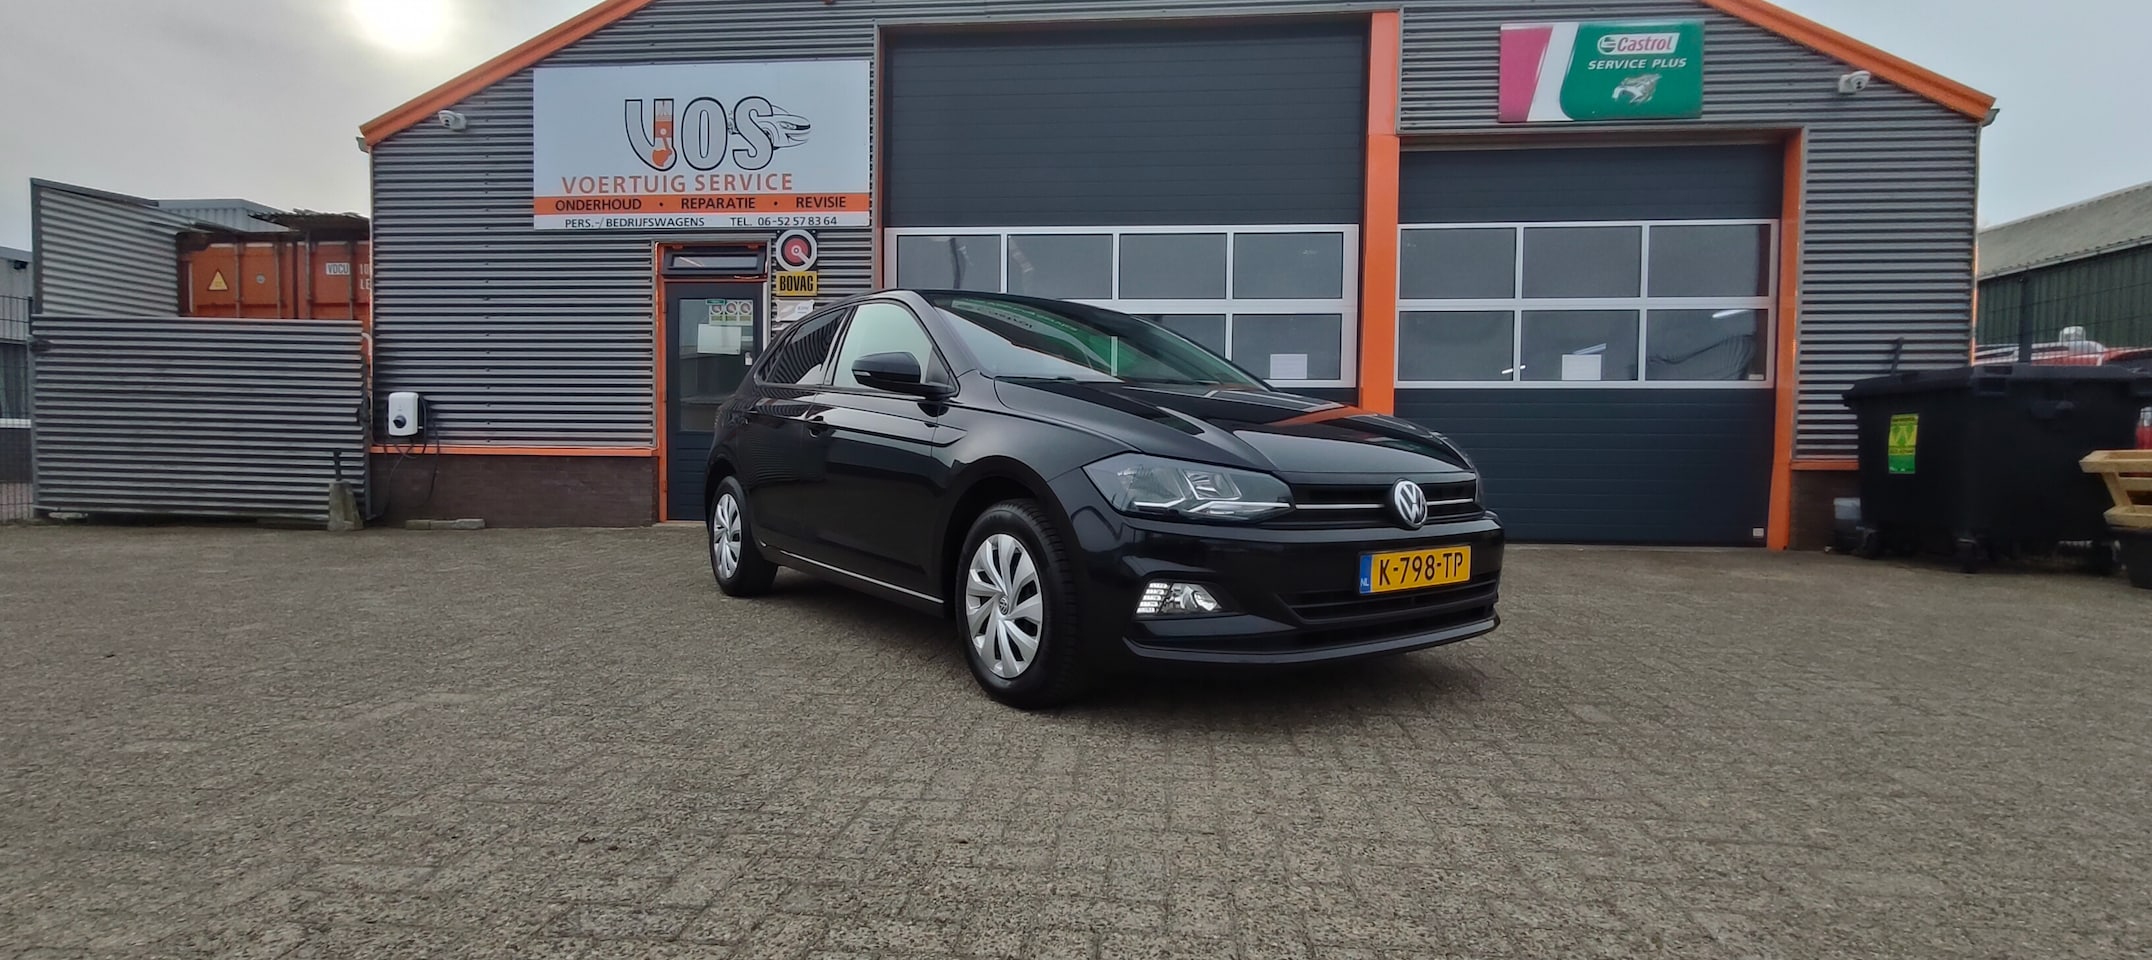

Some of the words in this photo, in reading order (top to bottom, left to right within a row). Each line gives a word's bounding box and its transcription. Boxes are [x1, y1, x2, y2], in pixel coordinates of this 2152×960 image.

[1617, 36, 1672, 52] Castrol
[1588, 59, 1646, 70] SERVICE
[1652, 58, 1687, 68] PLUS
[562, 175, 686, 194] VOERTUIG
[695, 173, 794, 192] SERVICE
[555, 198, 642, 212] ONDERHOUD
[681, 197, 756, 210] REPARATIE
[796, 196, 846, 209] REVISIE
[605, 216, 705, 228] BEDRIJFSWAGENS
[730, 217, 753, 227] TEL.
[779, 275, 814, 292] BOVAG
[1379, 552, 1463, 586] K-798-TP
[1360, 578, 1370, 587] NL
